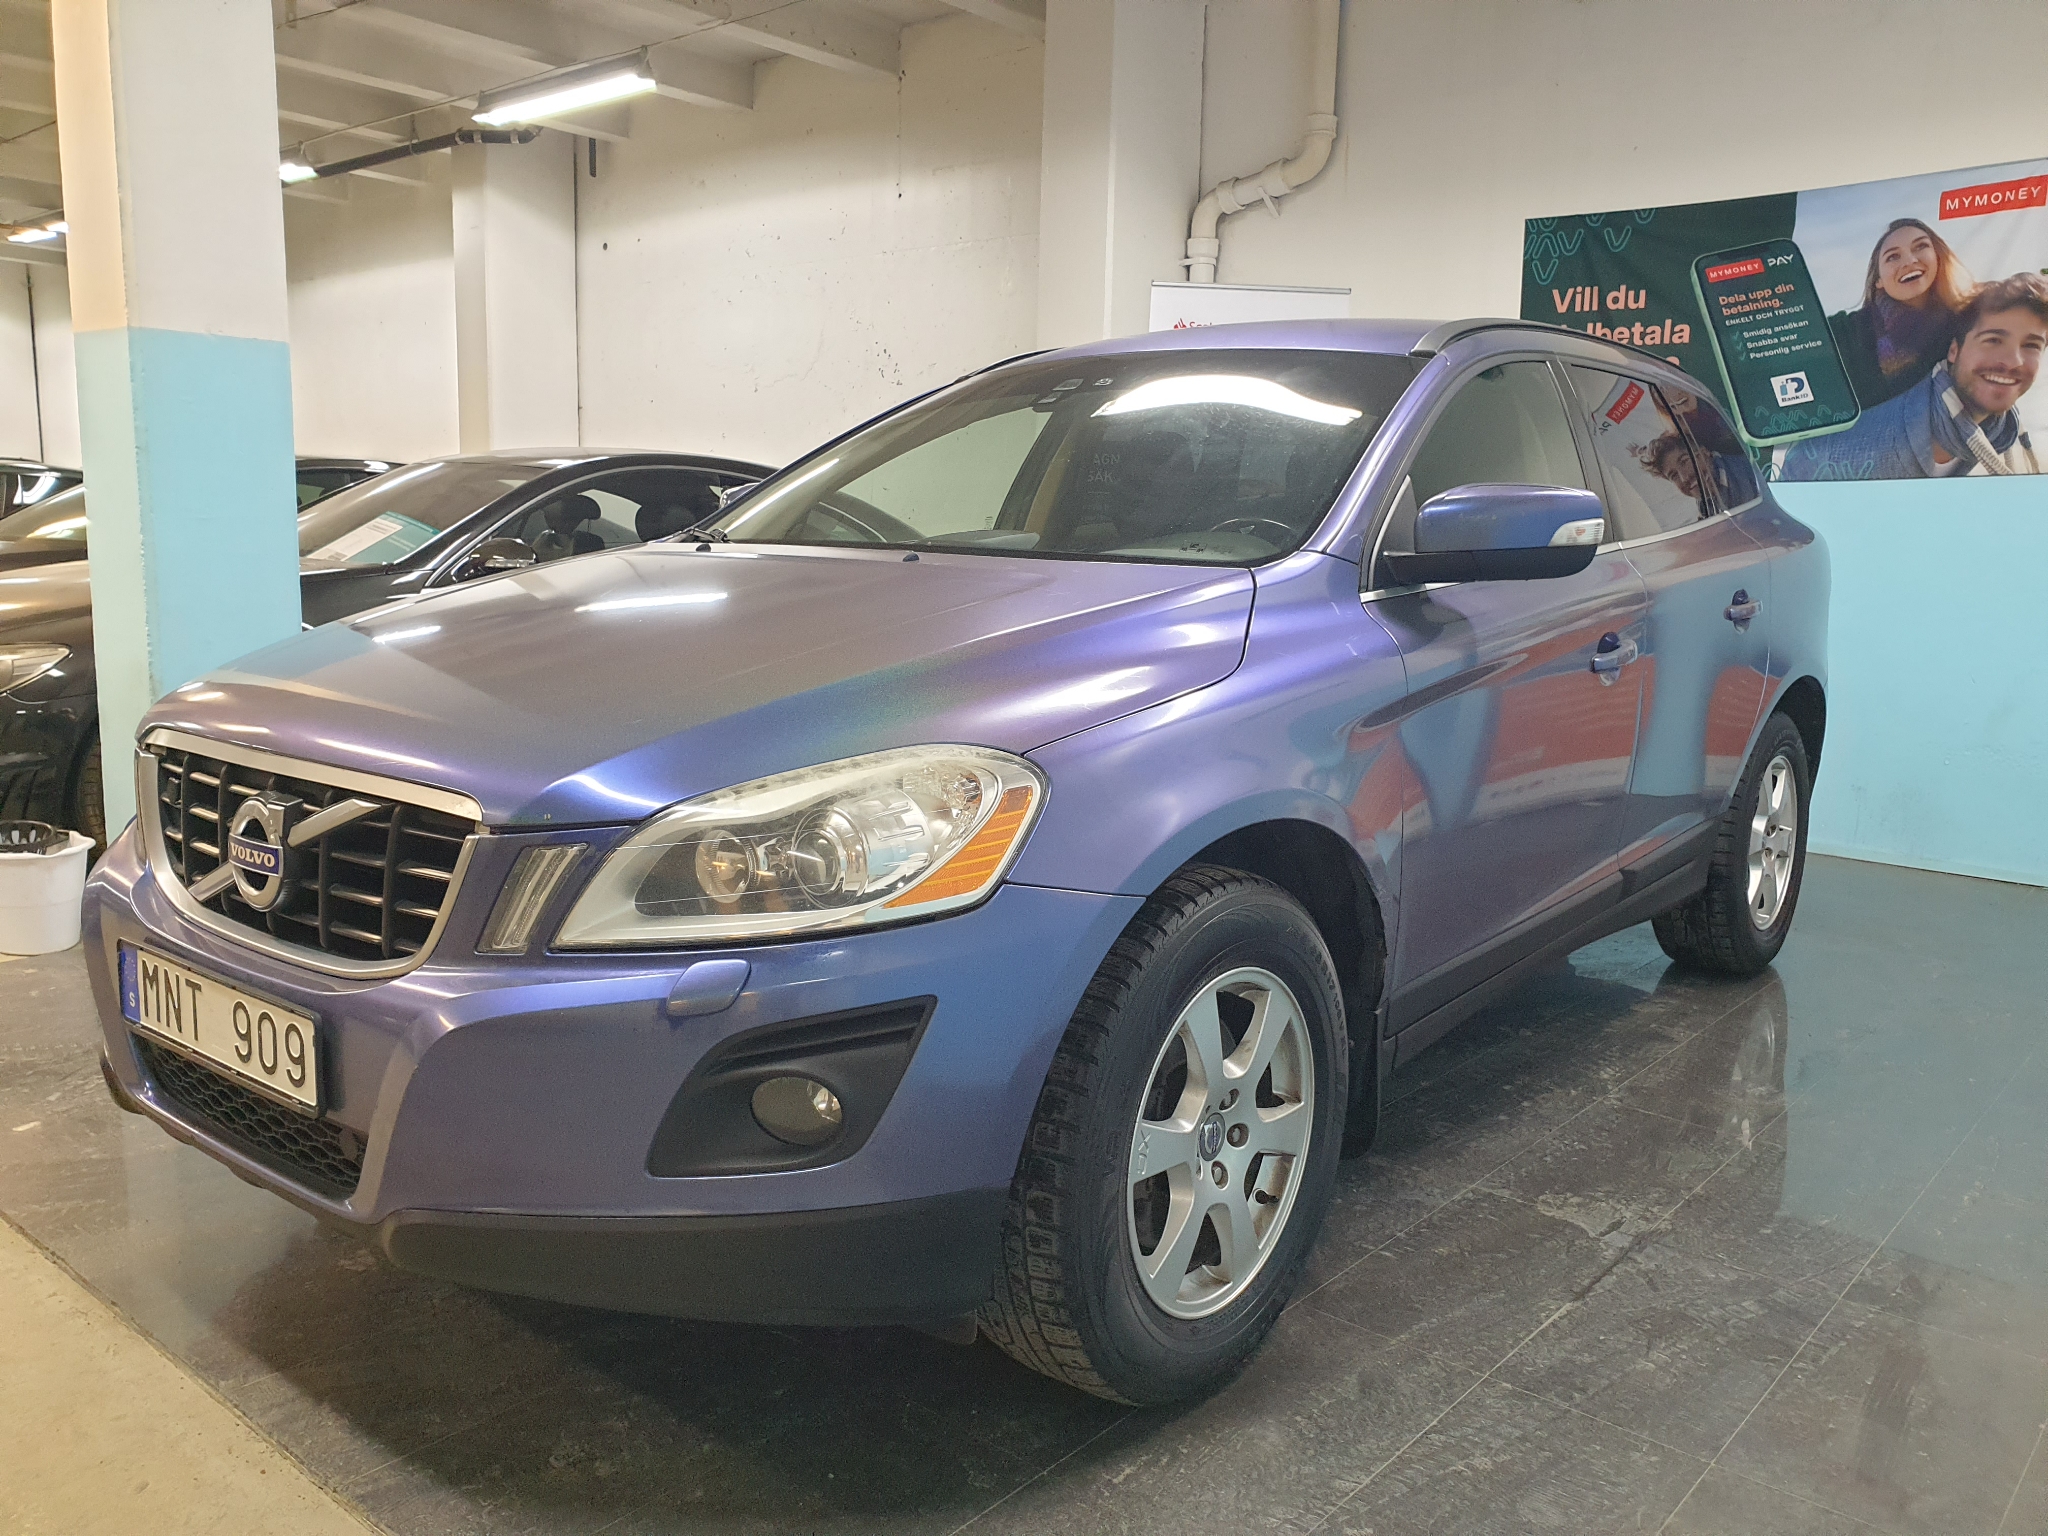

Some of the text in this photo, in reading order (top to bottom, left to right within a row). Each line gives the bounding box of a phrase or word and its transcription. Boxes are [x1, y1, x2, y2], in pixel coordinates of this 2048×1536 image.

[1946, 186, 2041, 210] MYMONEY
[1709, 254, 1794, 279] MYMONEY PAY
[1552, 285, 1647, 313] Vill du
[1719, 282, 1795, 306] Dela upp din
[1722, 297, 1784, 316] betalning.
[1725, 304, 1805, 327] ENKELT OCH TRYGGT
[1743, 320, 1809, 339] Smidig ansökan
[1746, 333, 1798, 349] Snabba svar
[1749, 340, 1822, 359] Personlig service
[228, 841, 275, 868] VOLVO
[129, 993, 136, 1008] S
[141, 960, 306, 1089] MNT 909
